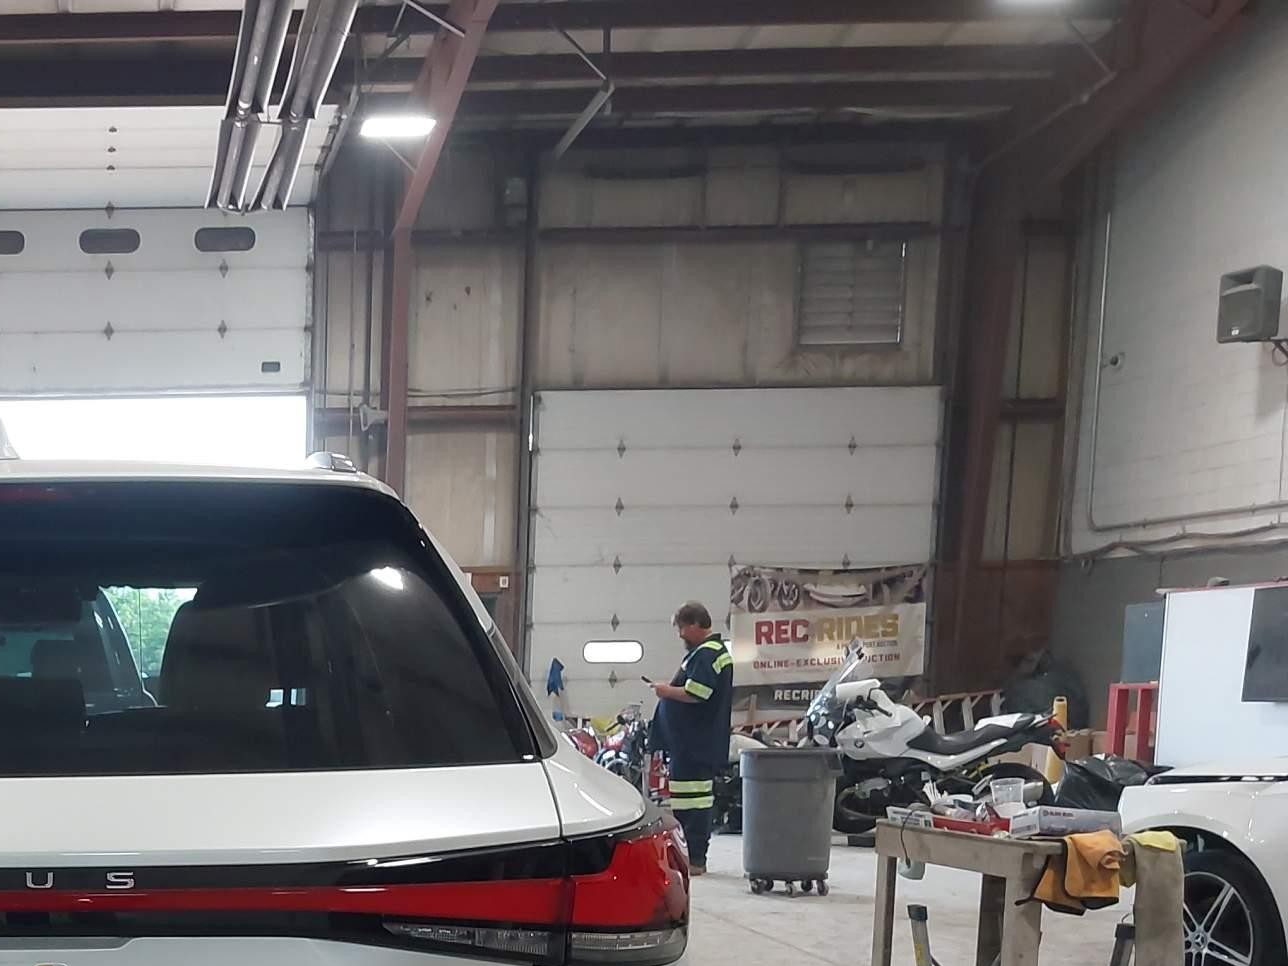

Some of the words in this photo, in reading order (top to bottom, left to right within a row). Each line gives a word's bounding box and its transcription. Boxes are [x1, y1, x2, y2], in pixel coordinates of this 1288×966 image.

[755, 619, 809, 645] REC
[817, 615, 899, 641] RIDES
[754, 656, 846, 669] ONLINE-EXCLUSIV
[863, 653, 901, 664] UCTION
